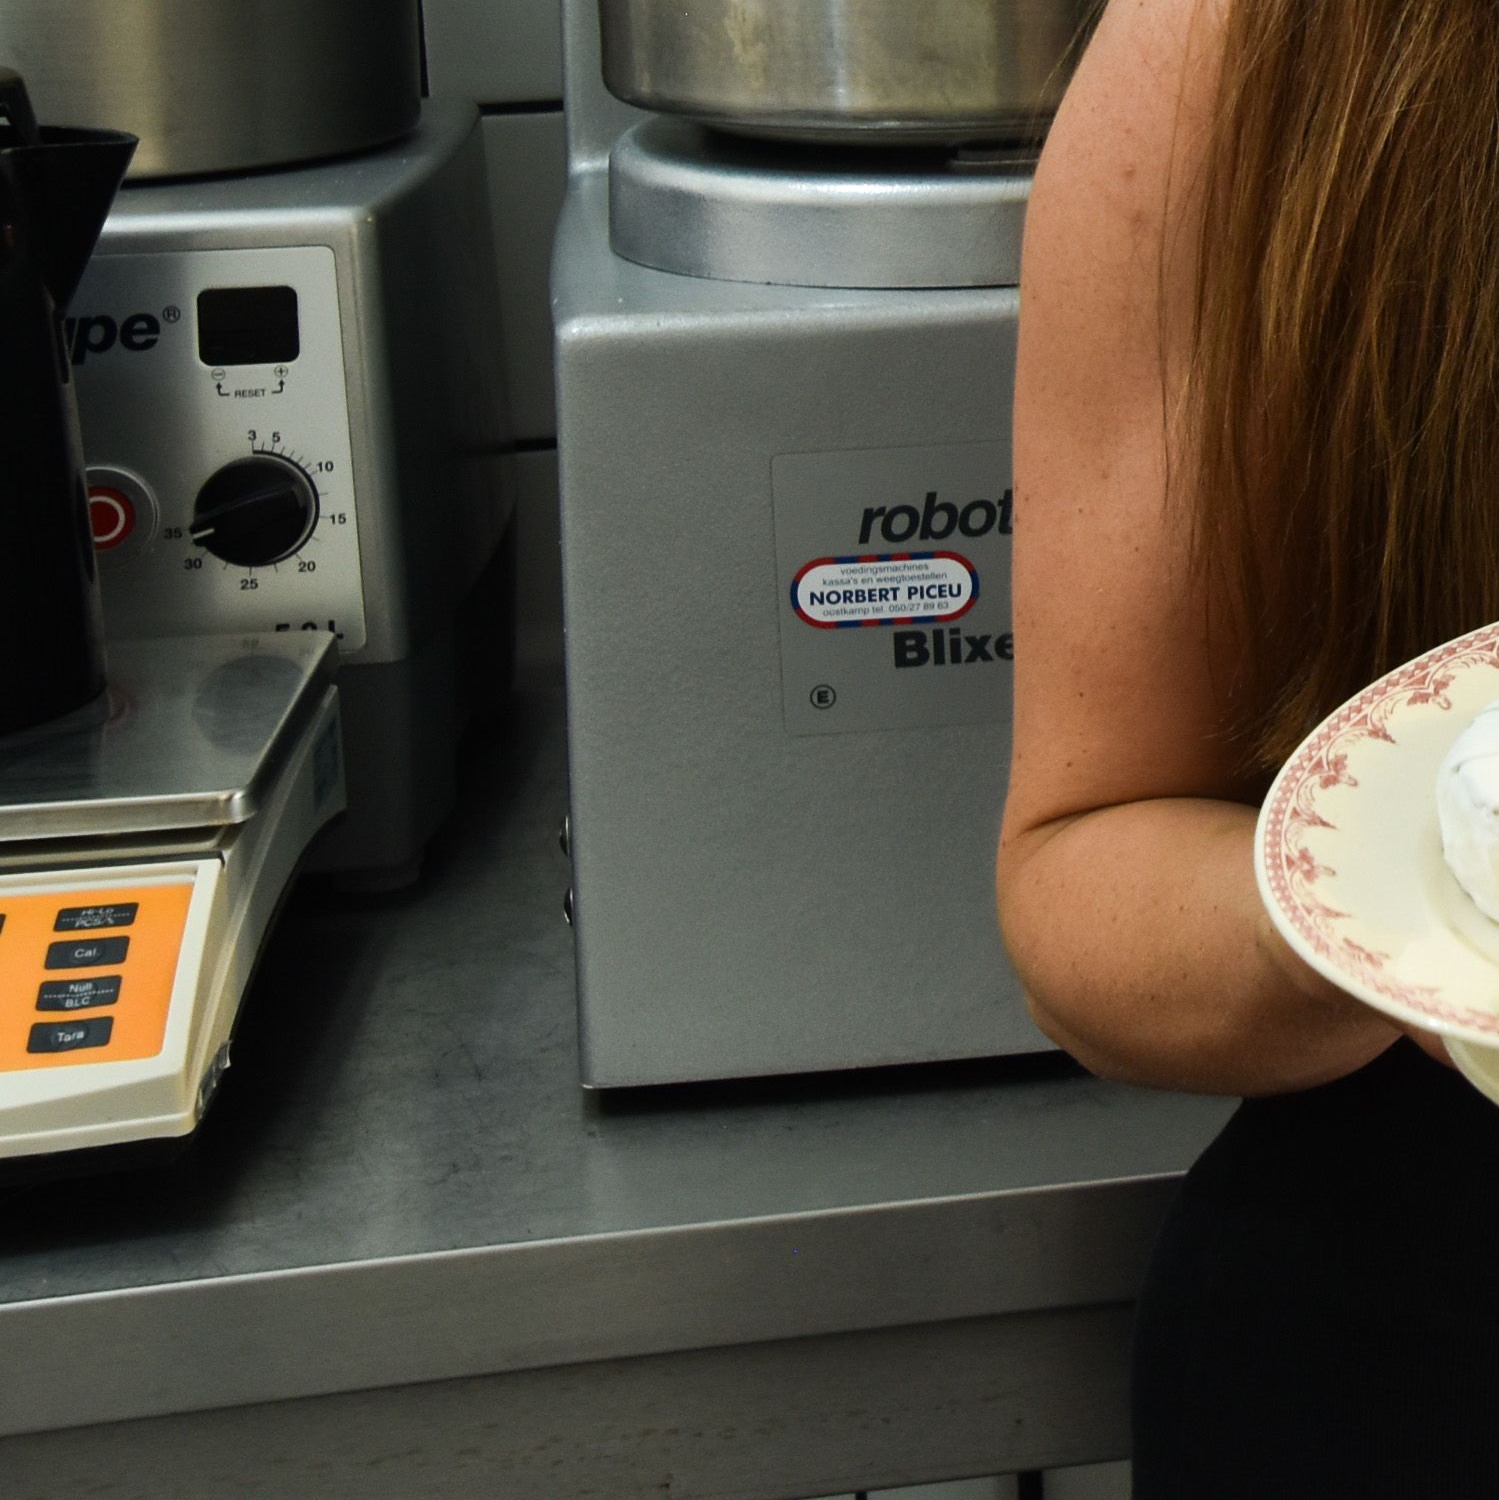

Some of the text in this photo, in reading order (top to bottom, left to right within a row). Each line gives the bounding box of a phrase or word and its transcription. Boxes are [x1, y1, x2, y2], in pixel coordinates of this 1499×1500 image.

[234, 387, 267, 398] RESET
[248, 430, 257, 441] 3
[272, 431, 281, 443] 5
[317, 460, 334, 473] 10
[330, 513, 347, 525] 15
[164, 527, 182, 540] 35
[184, 558, 202, 570] 30
[299, 560, 316, 573] 20
[240, 578, 259, 590] 25
[809, 583, 962, 606] NORBERT PICEU
[74, 947, 97, 959] Cal
[68, 981, 93, 994] Null
[64, 996, 91, 1008] BLC
[56, 1030, 85, 1044] Tara
